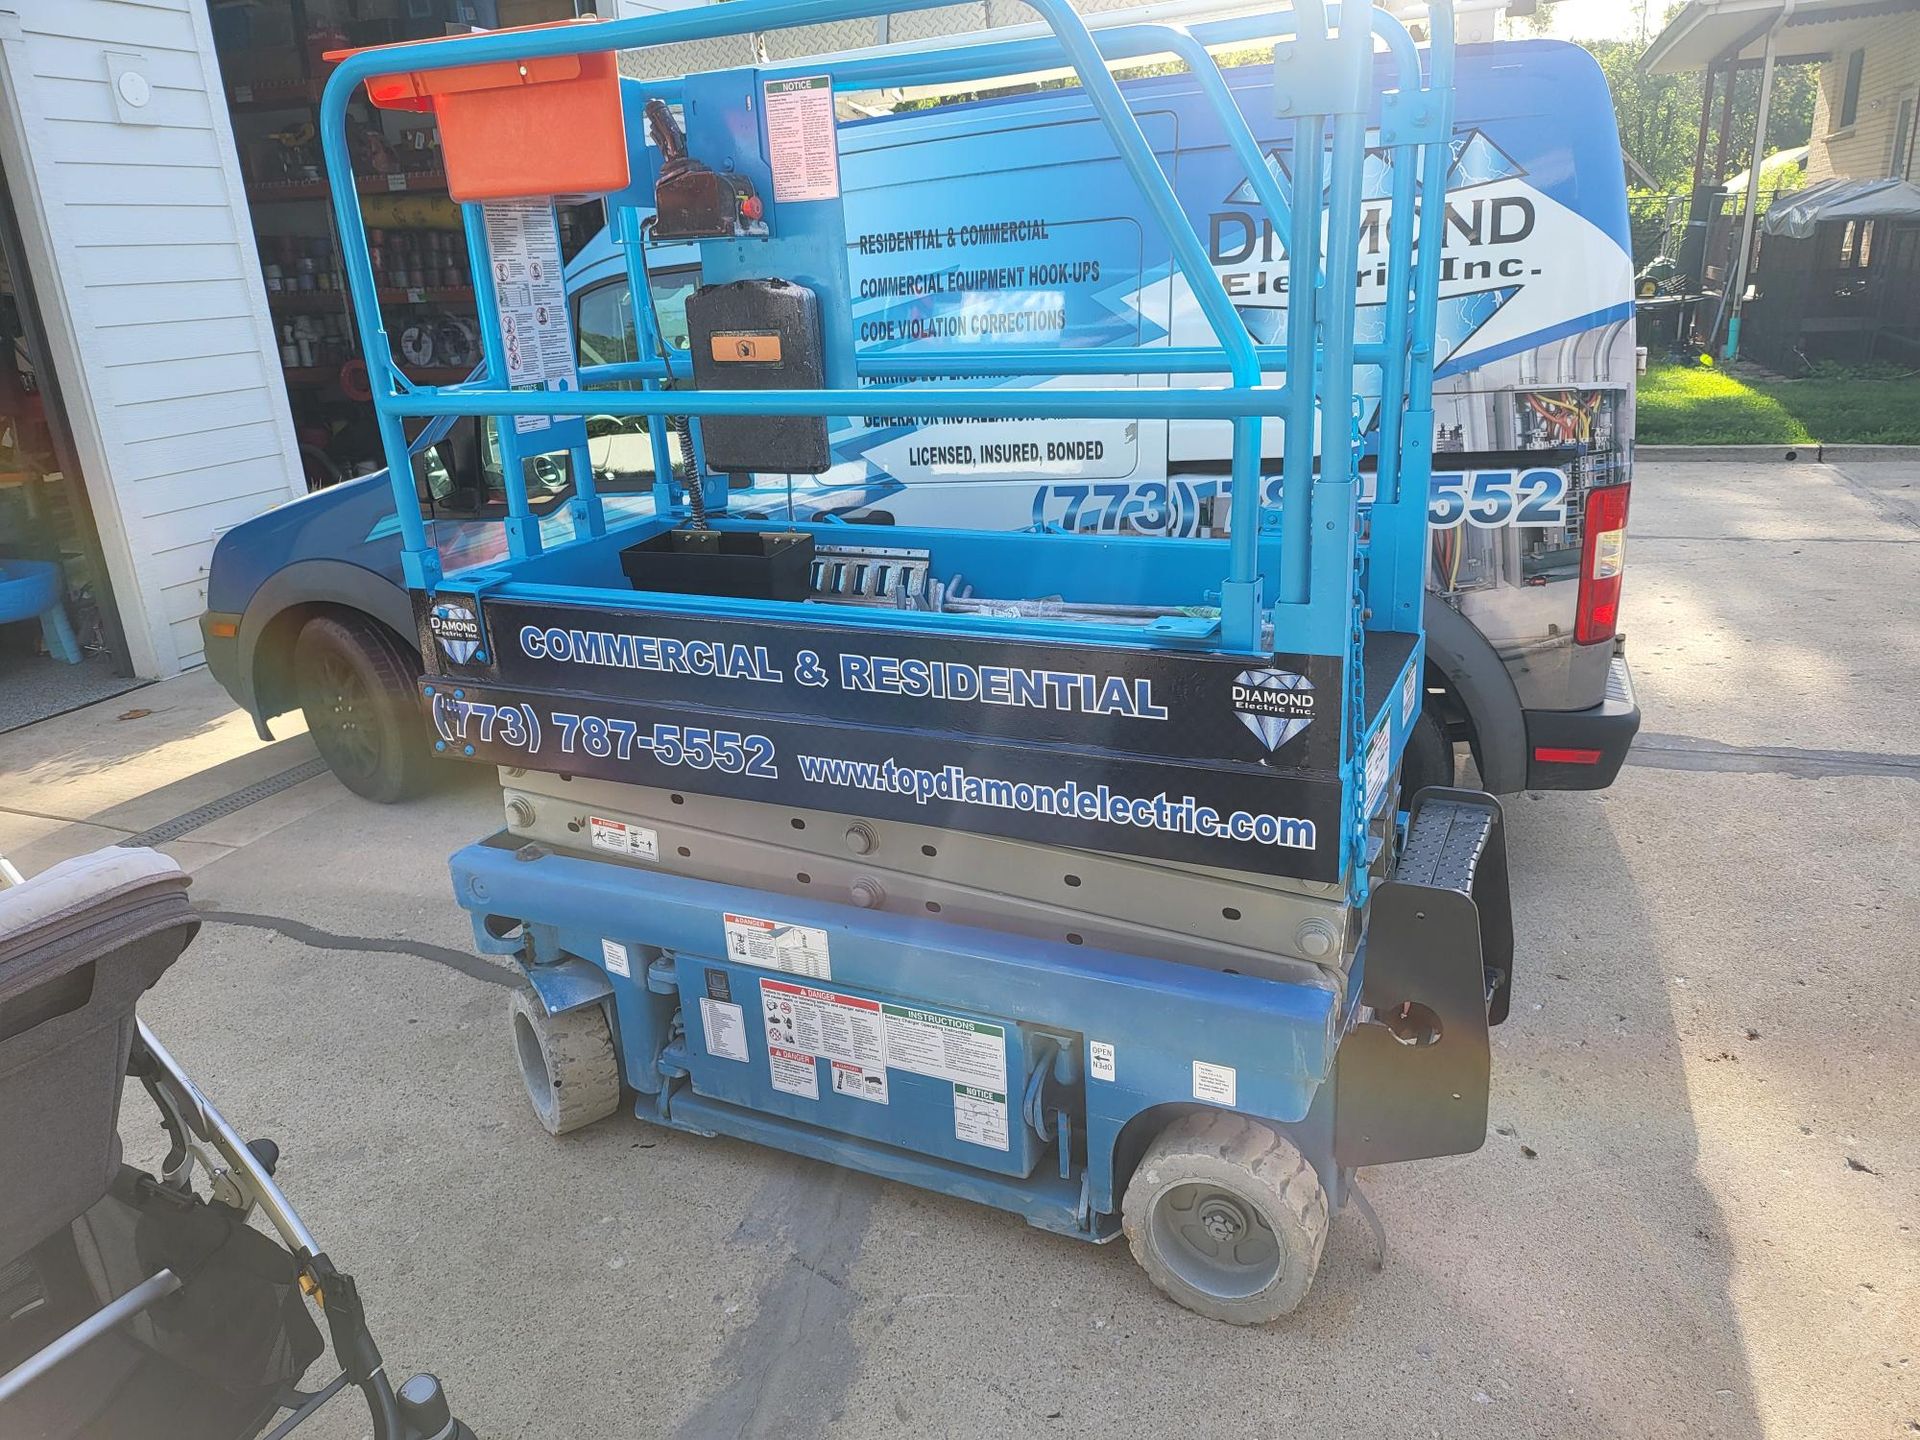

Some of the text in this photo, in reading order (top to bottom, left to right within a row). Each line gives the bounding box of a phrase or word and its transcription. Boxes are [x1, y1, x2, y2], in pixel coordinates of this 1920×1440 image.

[783, 80, 812, 91] NOTICE
[859, 219, 1049, 255] RESIDENTIAL & COMMERCIAL
[1208, 196, 1536, 266] DIND
[860, 260, 1100, 299] COMMERCIAL EQUIPMENT HOOK-UPS
[1222, 256, 1542, 297] Eleri Inc.
[860, 309, 1066, 342] CODE VIOLATION CORRECTIONS
[909, 440, 1104, 468] LICENSED, INSURED, BONDED
[1031, 482, 1198, 538] (773)
[519, 625, 1168, 720] COMMERCIAL & RESIDENTIAL
[1232, 686, 1314, 707] DIAMOND
[1236, 701, 1316, 716] Electric Inc.
[432, 693, 779, 780] (773) 787-5552
[796, 753, 1316, 850] www.topdiamondelectric.com
[740, 917, 765, 928] DANGER
[807, 990, 836, 1002] DANGER
[908, 1010, 975, 1031] INSTRUCTIONS
[783, 1050, 811, 1064] DANGER
[1092, 1046, 1112, 1057] OPEN
[966, 1087, 993, 1100] NOTICE
